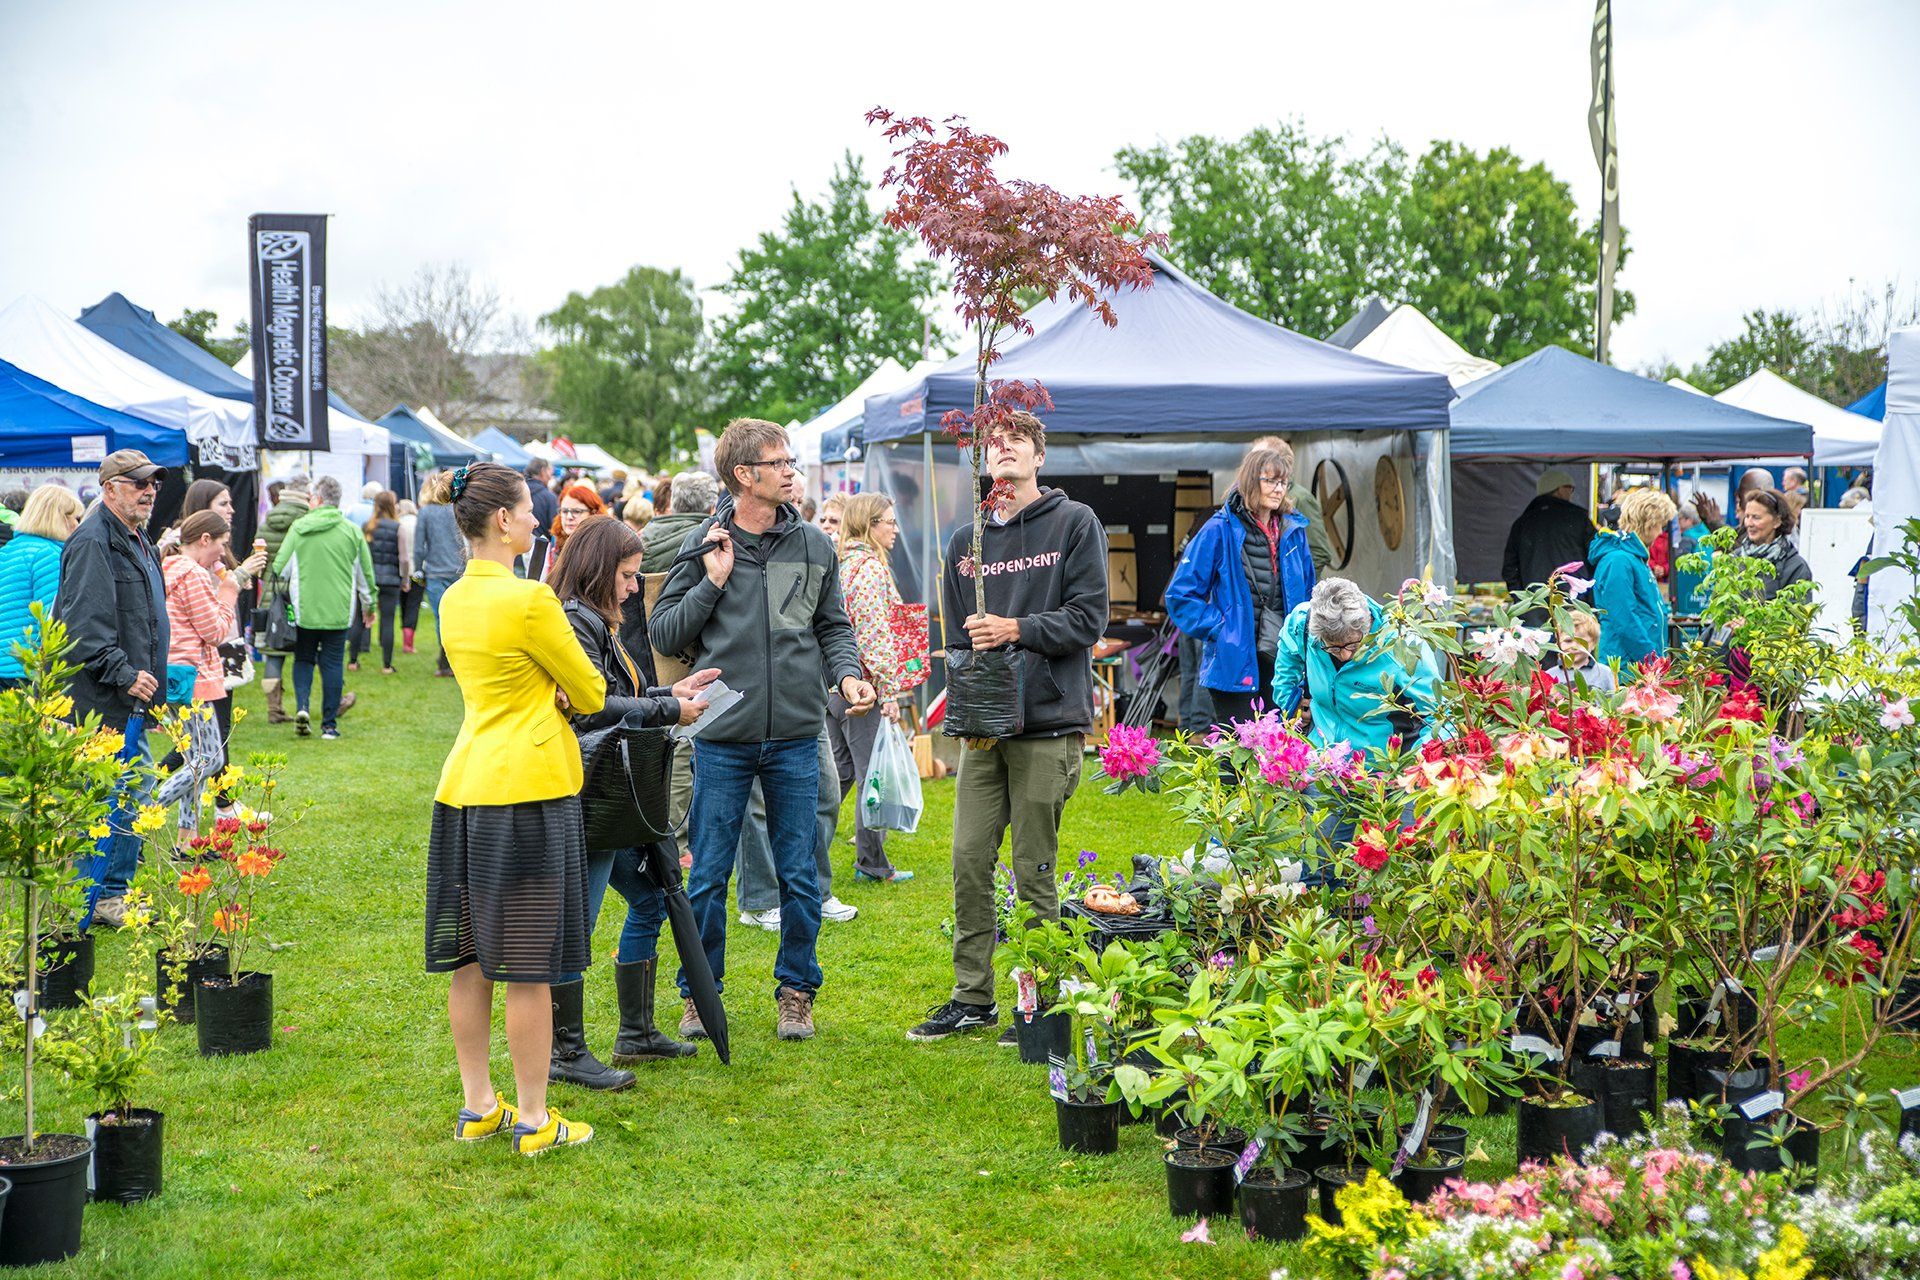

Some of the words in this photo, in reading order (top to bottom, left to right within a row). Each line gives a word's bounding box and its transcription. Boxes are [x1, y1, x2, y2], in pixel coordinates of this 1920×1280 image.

[272, 260, 299, 303] Health
[266, 305, 300, 365] Magnetic
[270, 366, 300, 415] Copper
